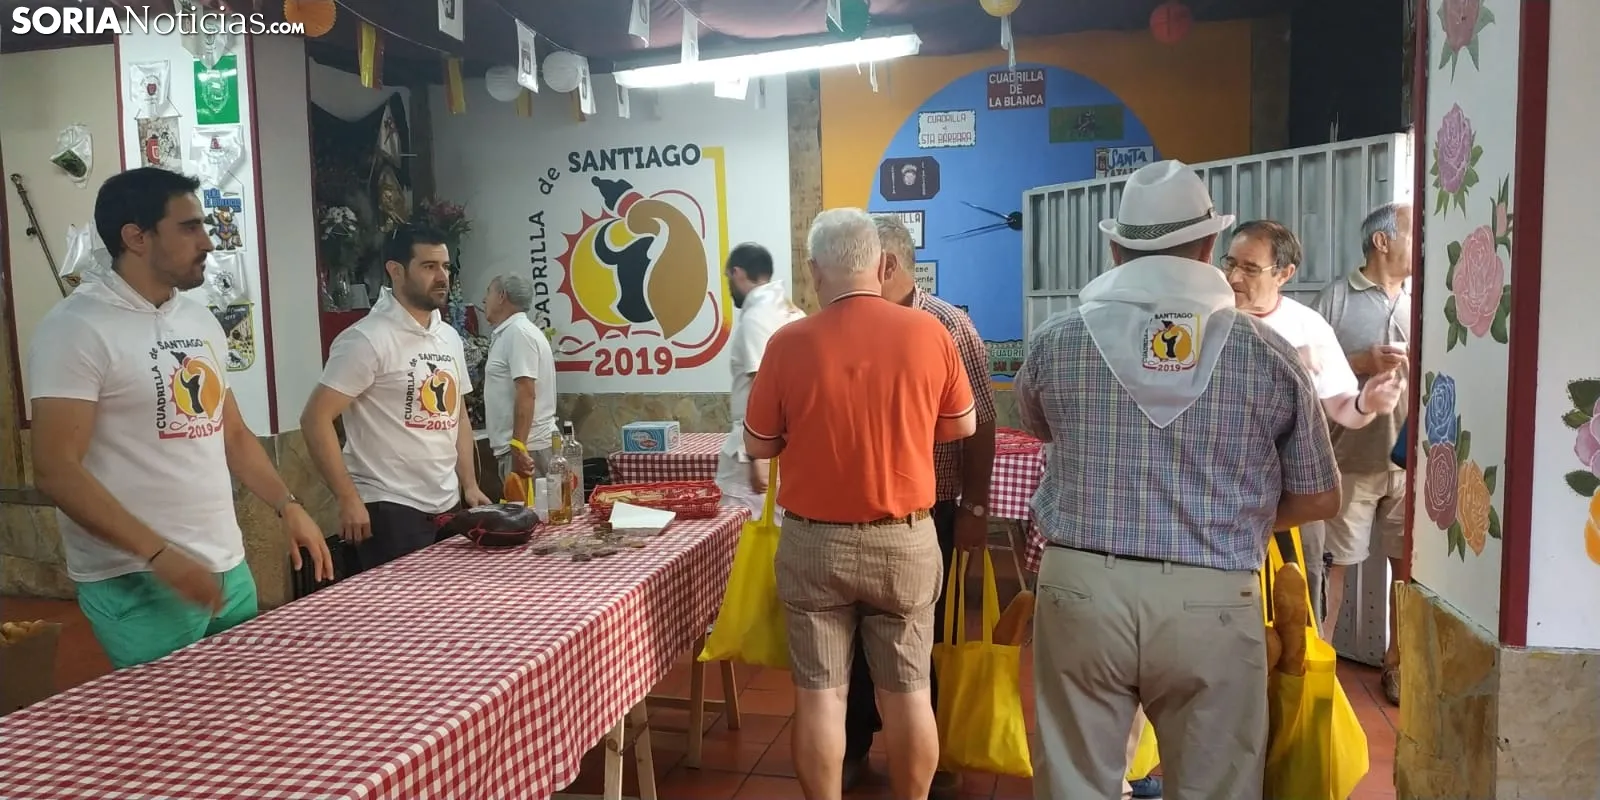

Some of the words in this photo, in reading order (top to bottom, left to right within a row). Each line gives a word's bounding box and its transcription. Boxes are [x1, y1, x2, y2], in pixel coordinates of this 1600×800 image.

[989, 70, 1043, 84] CUADRILLA
[1010, 84, 1023, 95] DE
[989, 97, 1001, 108] LA
[1004, 94, 1043, 106] BLANCA
[927, 113, 966, 124] CUADRILLA
[538, 167, 561, 196] de
[568, 143, 701, 174] SANTIAGO
[1154, 312, 1193, 320] SANTIAGO
[157, 338, 203, 351] SANTIAGO
[149, 347, 159, 360] de
[594, 346, 673, 377] 2019
[1157, 363, 1181, 372] 2019
[151, 365, 167, 430] CUADRILLA
[404, 371, 415, 421] CUADRILLA
[187, 422, 214, 440] 2019
